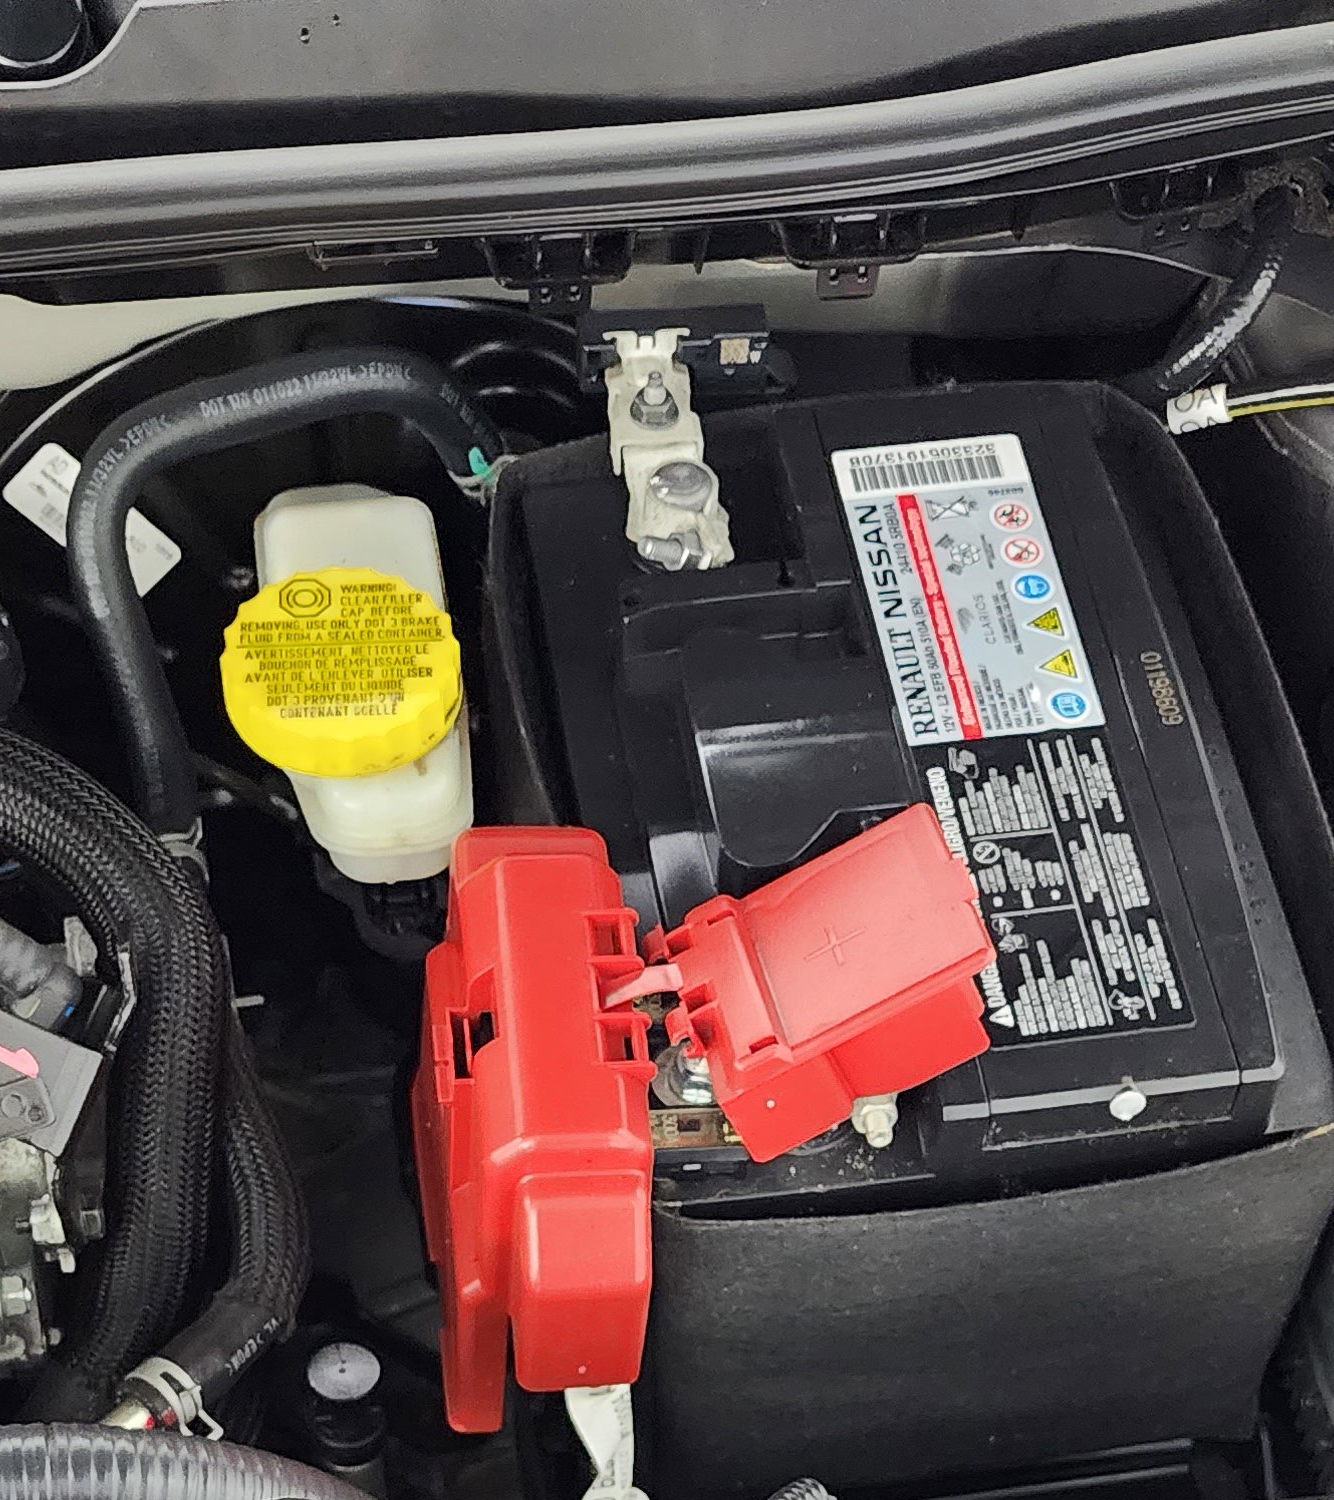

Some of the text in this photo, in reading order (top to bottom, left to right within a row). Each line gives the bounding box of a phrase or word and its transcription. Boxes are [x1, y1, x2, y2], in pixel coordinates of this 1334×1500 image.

[340, 595, 380, 606] CLEAN
[340, 605, 412, 617] CAP BEFORE
[972, 591, 996, 645] CLARIOS
[305, 619, 326, 630] USE
[330, 618, 360, 629] ONLY
[364, 617, 386, 627] DOT
[401, 616, 439, 626] BRAKE
[854, 503, 939, 738] RENAULT NISSAN
[239, 634, 273, 644] FLUID
[278, 632, 310, 642] FROM
[327, 630, 374, 640] SEALED
[351, 645, 413, 656] NETTOYER
[415, 644, 429, 653] LE
[259, 655, 417, 670] BOUCHON DE REMPLISSAGE
[244, 672, 286, 683] AVANT
[290, 671, 304, 681] DE
[381, 666, 432, 678] UTILISER
[266, 679, 403, 694] SEULEMENT DU LIQUIDE
[266, 696, 288, 706] DOT
[303, 692, 369, 704] PROVENANT
[280, 706, 348, 719] CONTENANT
